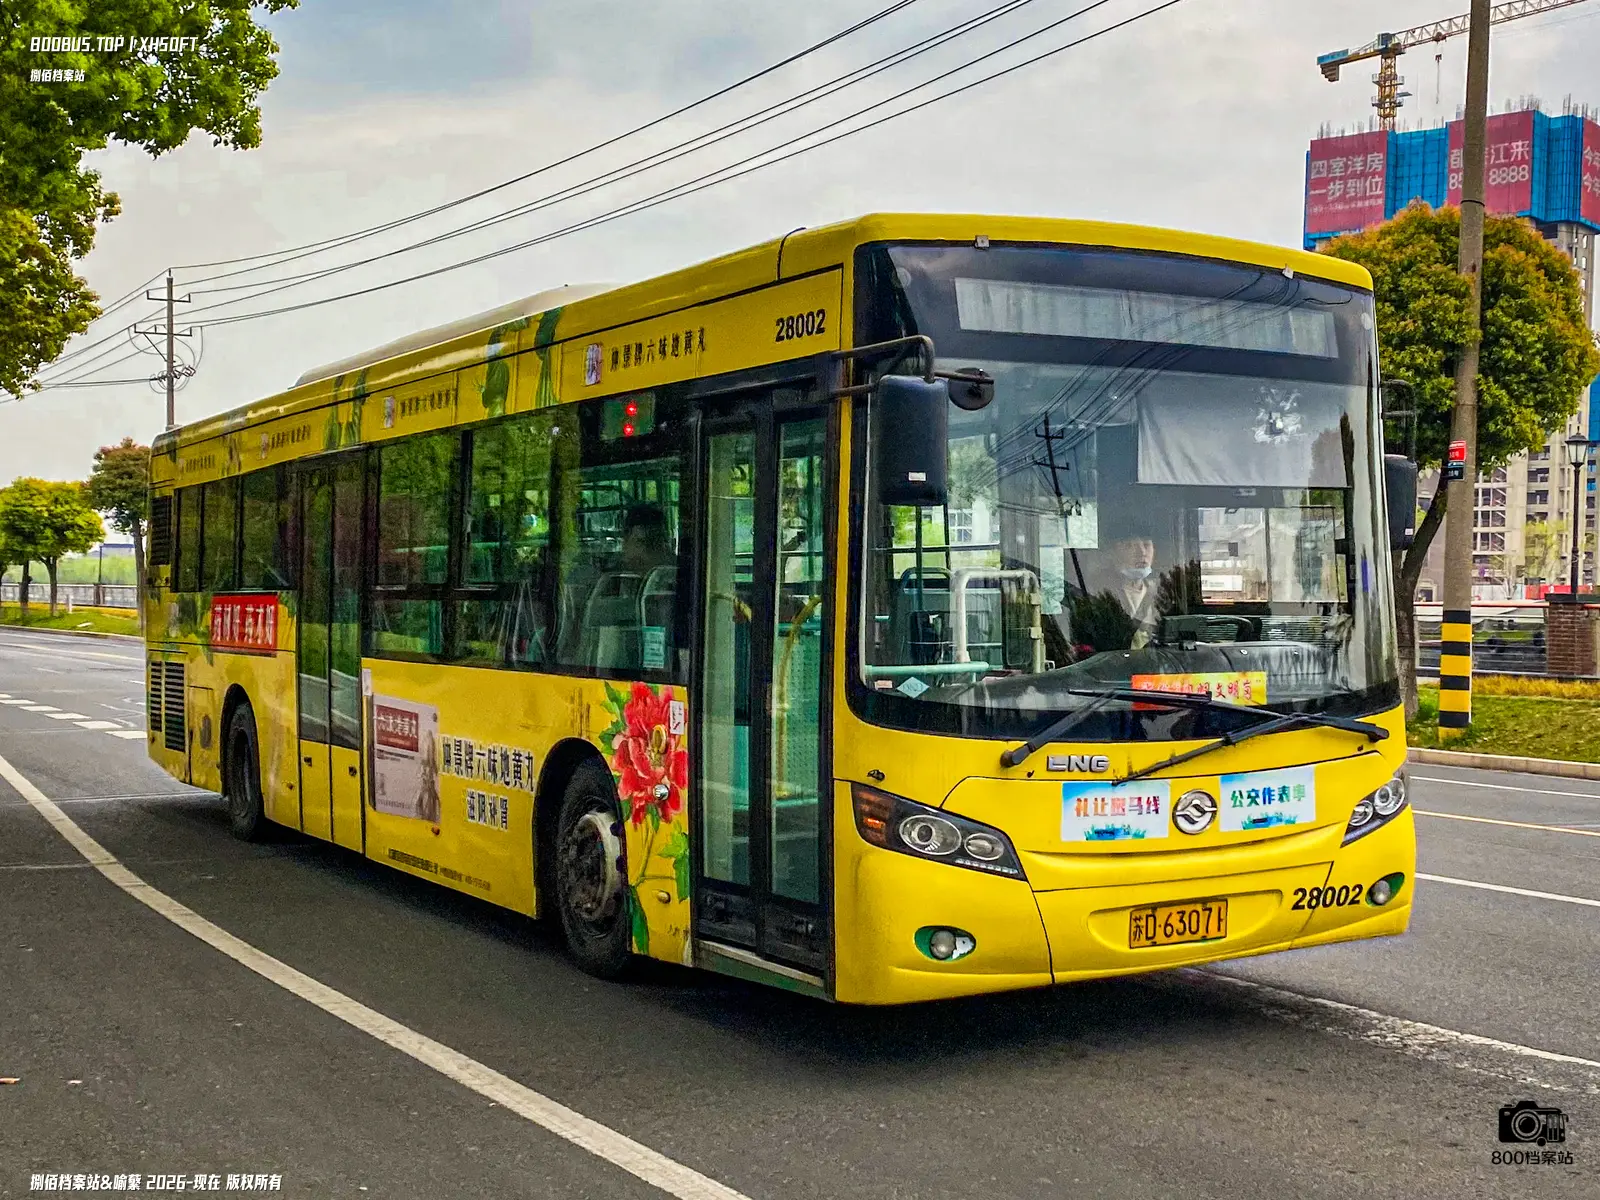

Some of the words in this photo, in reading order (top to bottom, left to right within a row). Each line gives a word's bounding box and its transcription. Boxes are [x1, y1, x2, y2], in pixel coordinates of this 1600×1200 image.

[1310, 152, 1384, 179] 四室洋房
[1450, 140, 1531, 169] 都江来
[1309, 175, 1383, 200] 一步到位
[775, 308, 826, 343] 28002
[1046, 755, 1110, 773] LNG
[1075, 796, 1160, 817] 礼让斑马线
[1291, 884, 1364, 911] 28002
